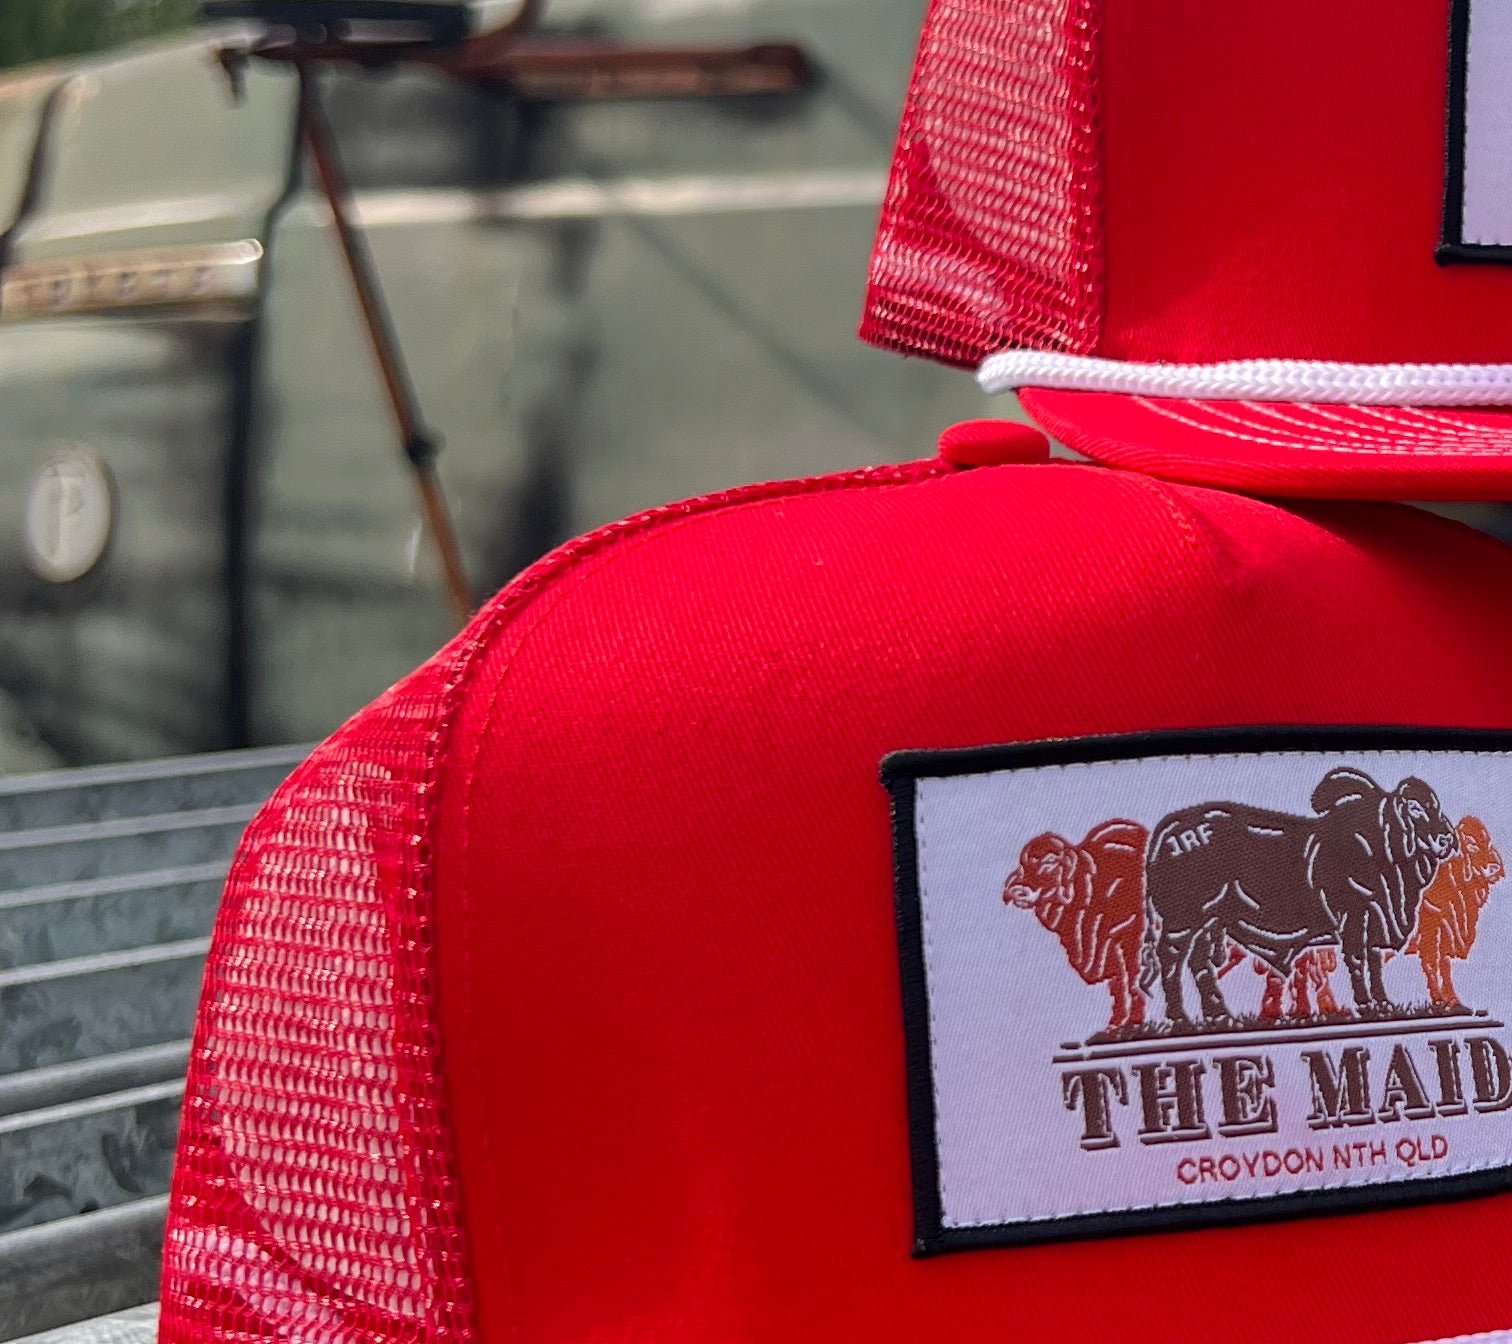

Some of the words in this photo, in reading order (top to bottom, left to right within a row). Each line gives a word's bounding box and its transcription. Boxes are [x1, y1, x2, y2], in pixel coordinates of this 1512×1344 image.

[1061, 1054, 1279, 1152] THE
[1176, 1144, 1324, 1186] CROYDON
[1332, 1140, 1387, 1170] NTH
[1394, 1134, 1449, 1168] QLD
